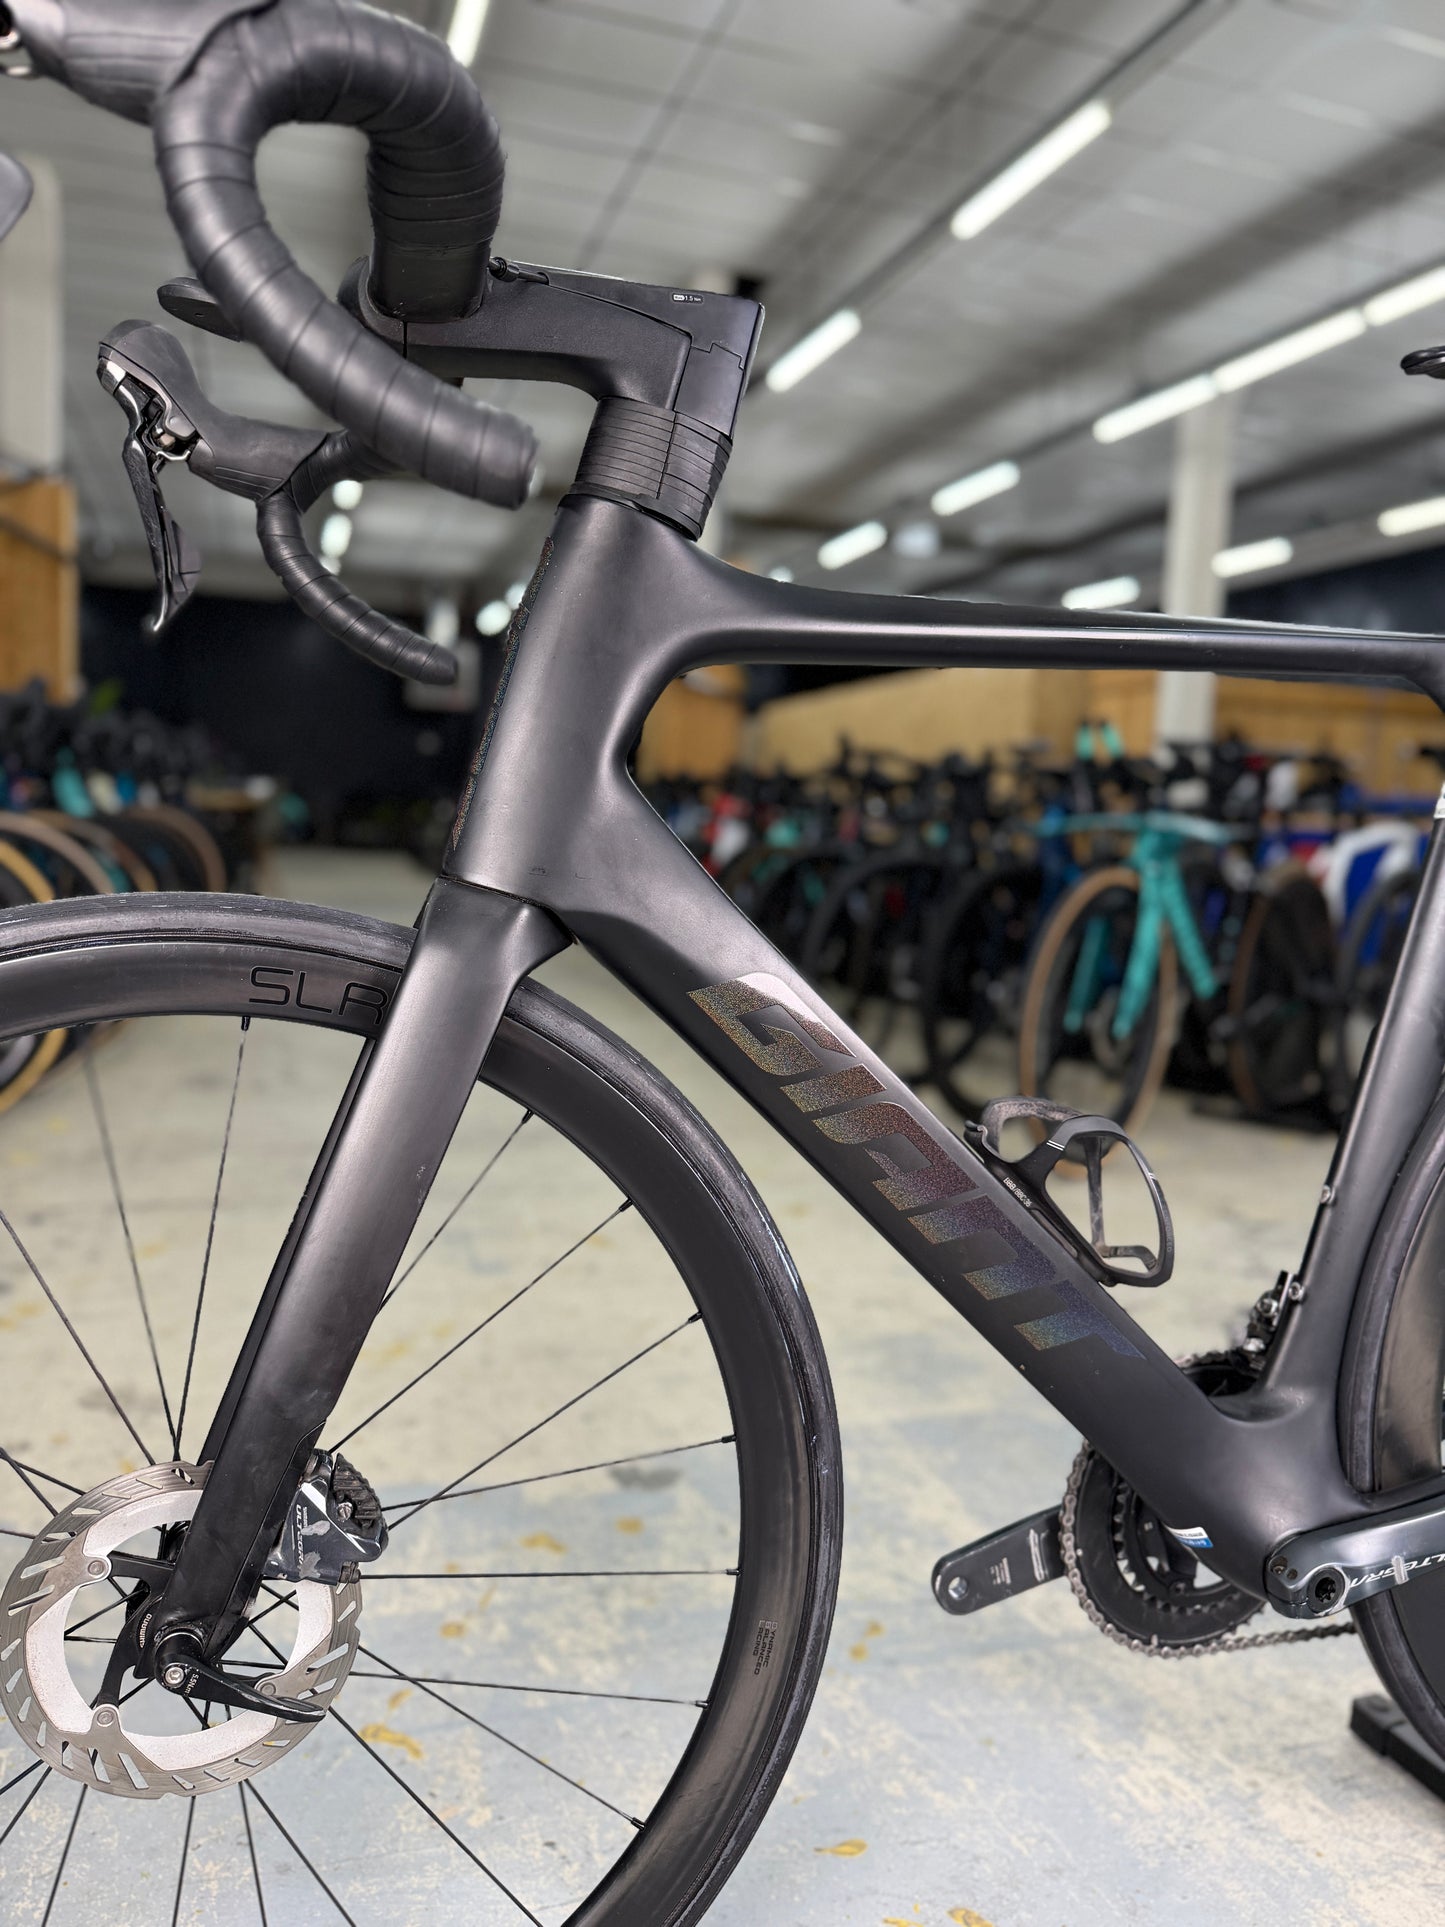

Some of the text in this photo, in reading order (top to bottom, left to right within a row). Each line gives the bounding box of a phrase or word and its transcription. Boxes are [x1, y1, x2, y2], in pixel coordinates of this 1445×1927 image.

[249, 966, 388, 1025] SLR
[686, 972, 1147, 1360] GIANT
[1350, 1553, 1445, 1588] LTEGRA
[753, 1620, 766, 1656] LACING
[754, 1621, 772, 1675] BALANCED
[762, 1622, 778, 1668] DYNAMIC
